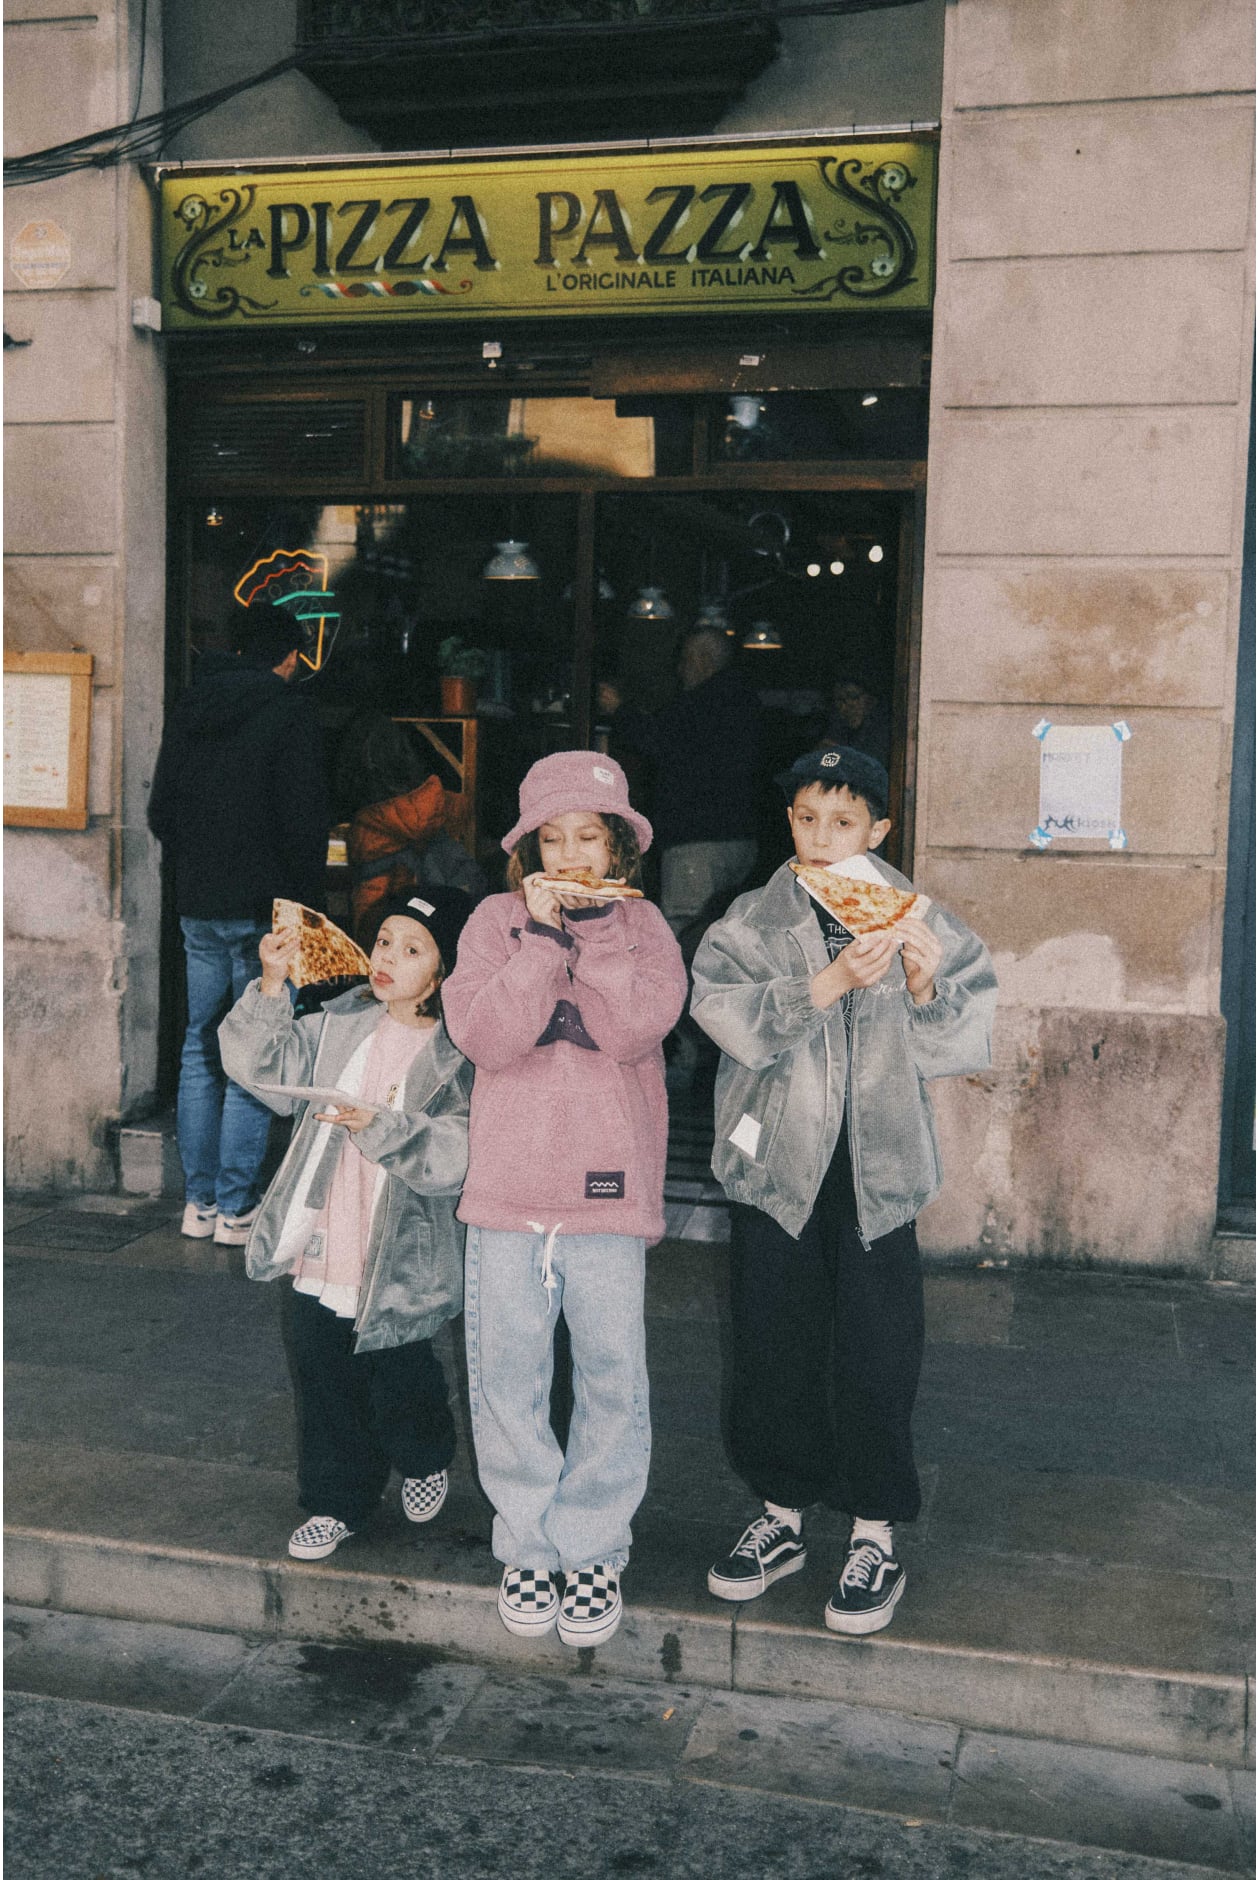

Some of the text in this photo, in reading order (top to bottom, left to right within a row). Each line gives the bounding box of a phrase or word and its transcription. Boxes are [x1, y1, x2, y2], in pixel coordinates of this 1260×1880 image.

[228, 181, 823, 278] LA PIZZA PAZZA
[546, 265, 795, 292] L'ORIGINALE ITALIANA
